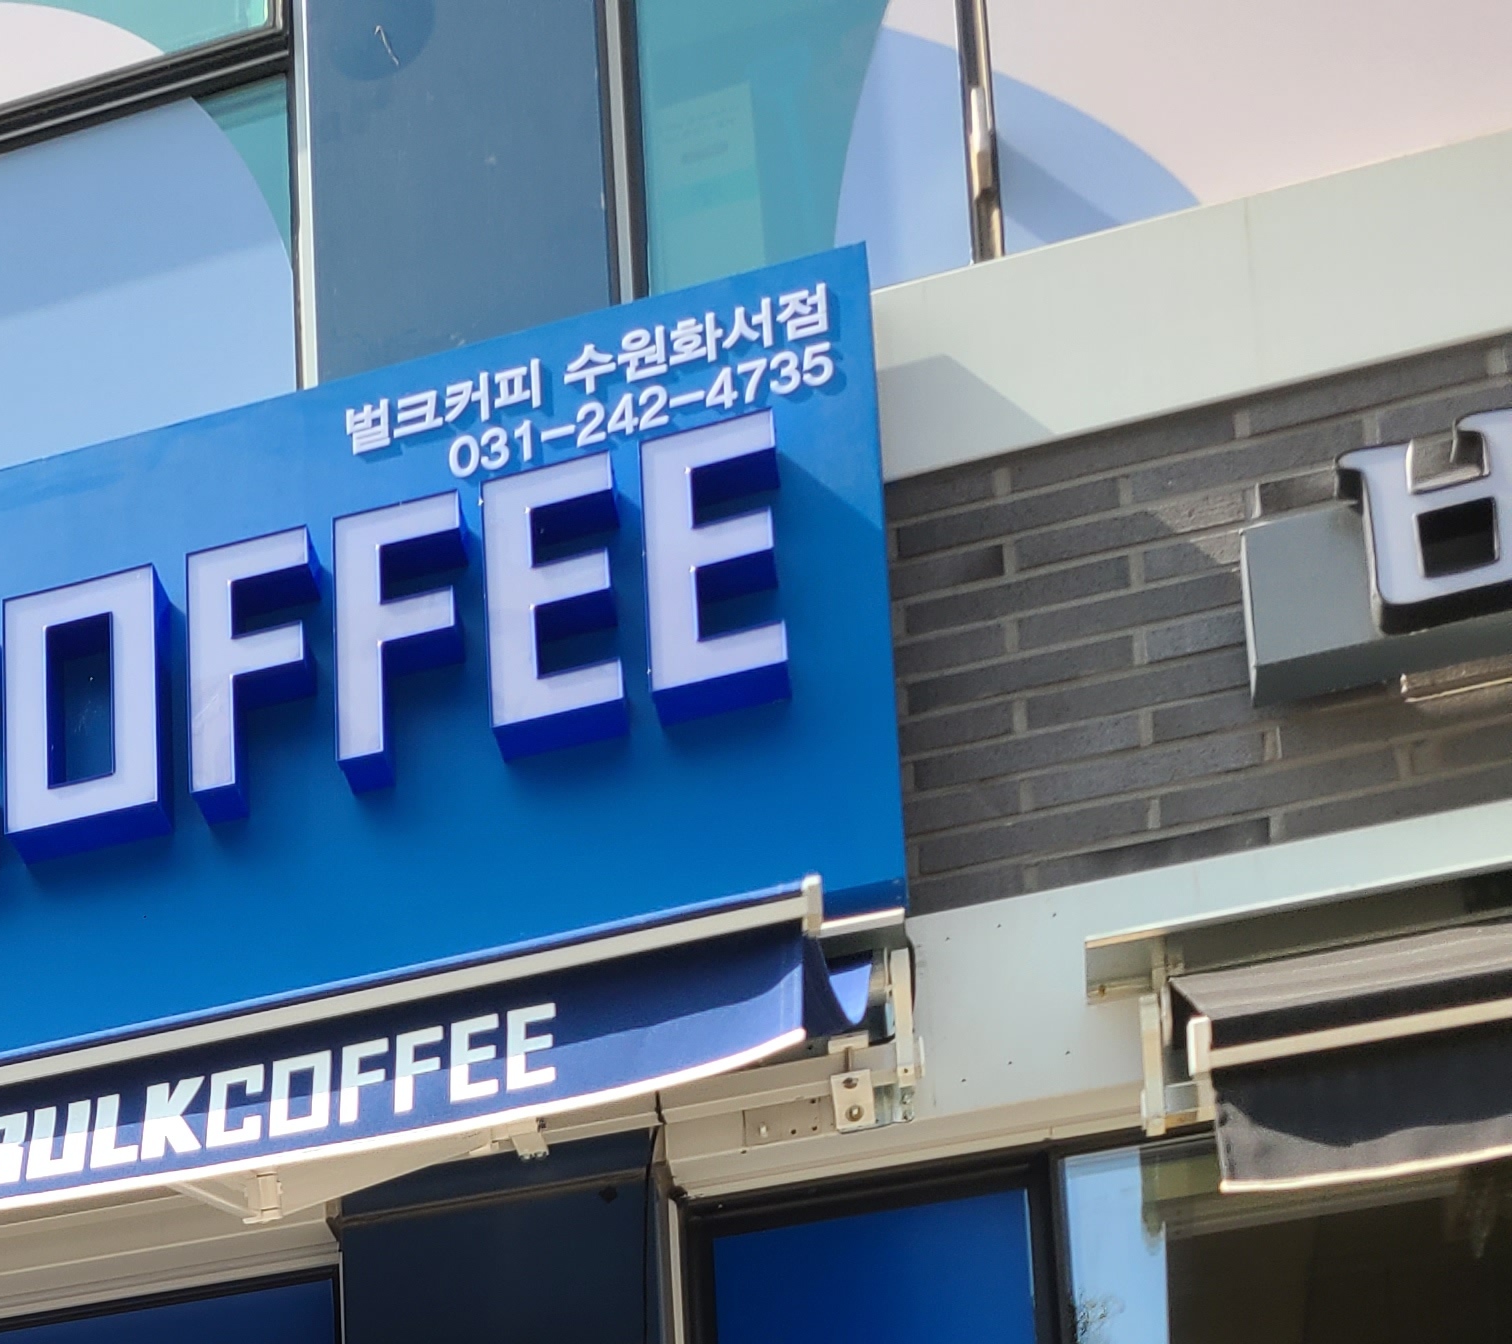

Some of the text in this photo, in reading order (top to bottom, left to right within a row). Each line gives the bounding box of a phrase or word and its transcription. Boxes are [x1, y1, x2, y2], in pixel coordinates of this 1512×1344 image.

[345, 283, 829, 455] 벌크커피 수원화서점
[448, 341, 835, 479] 031-242-4735
